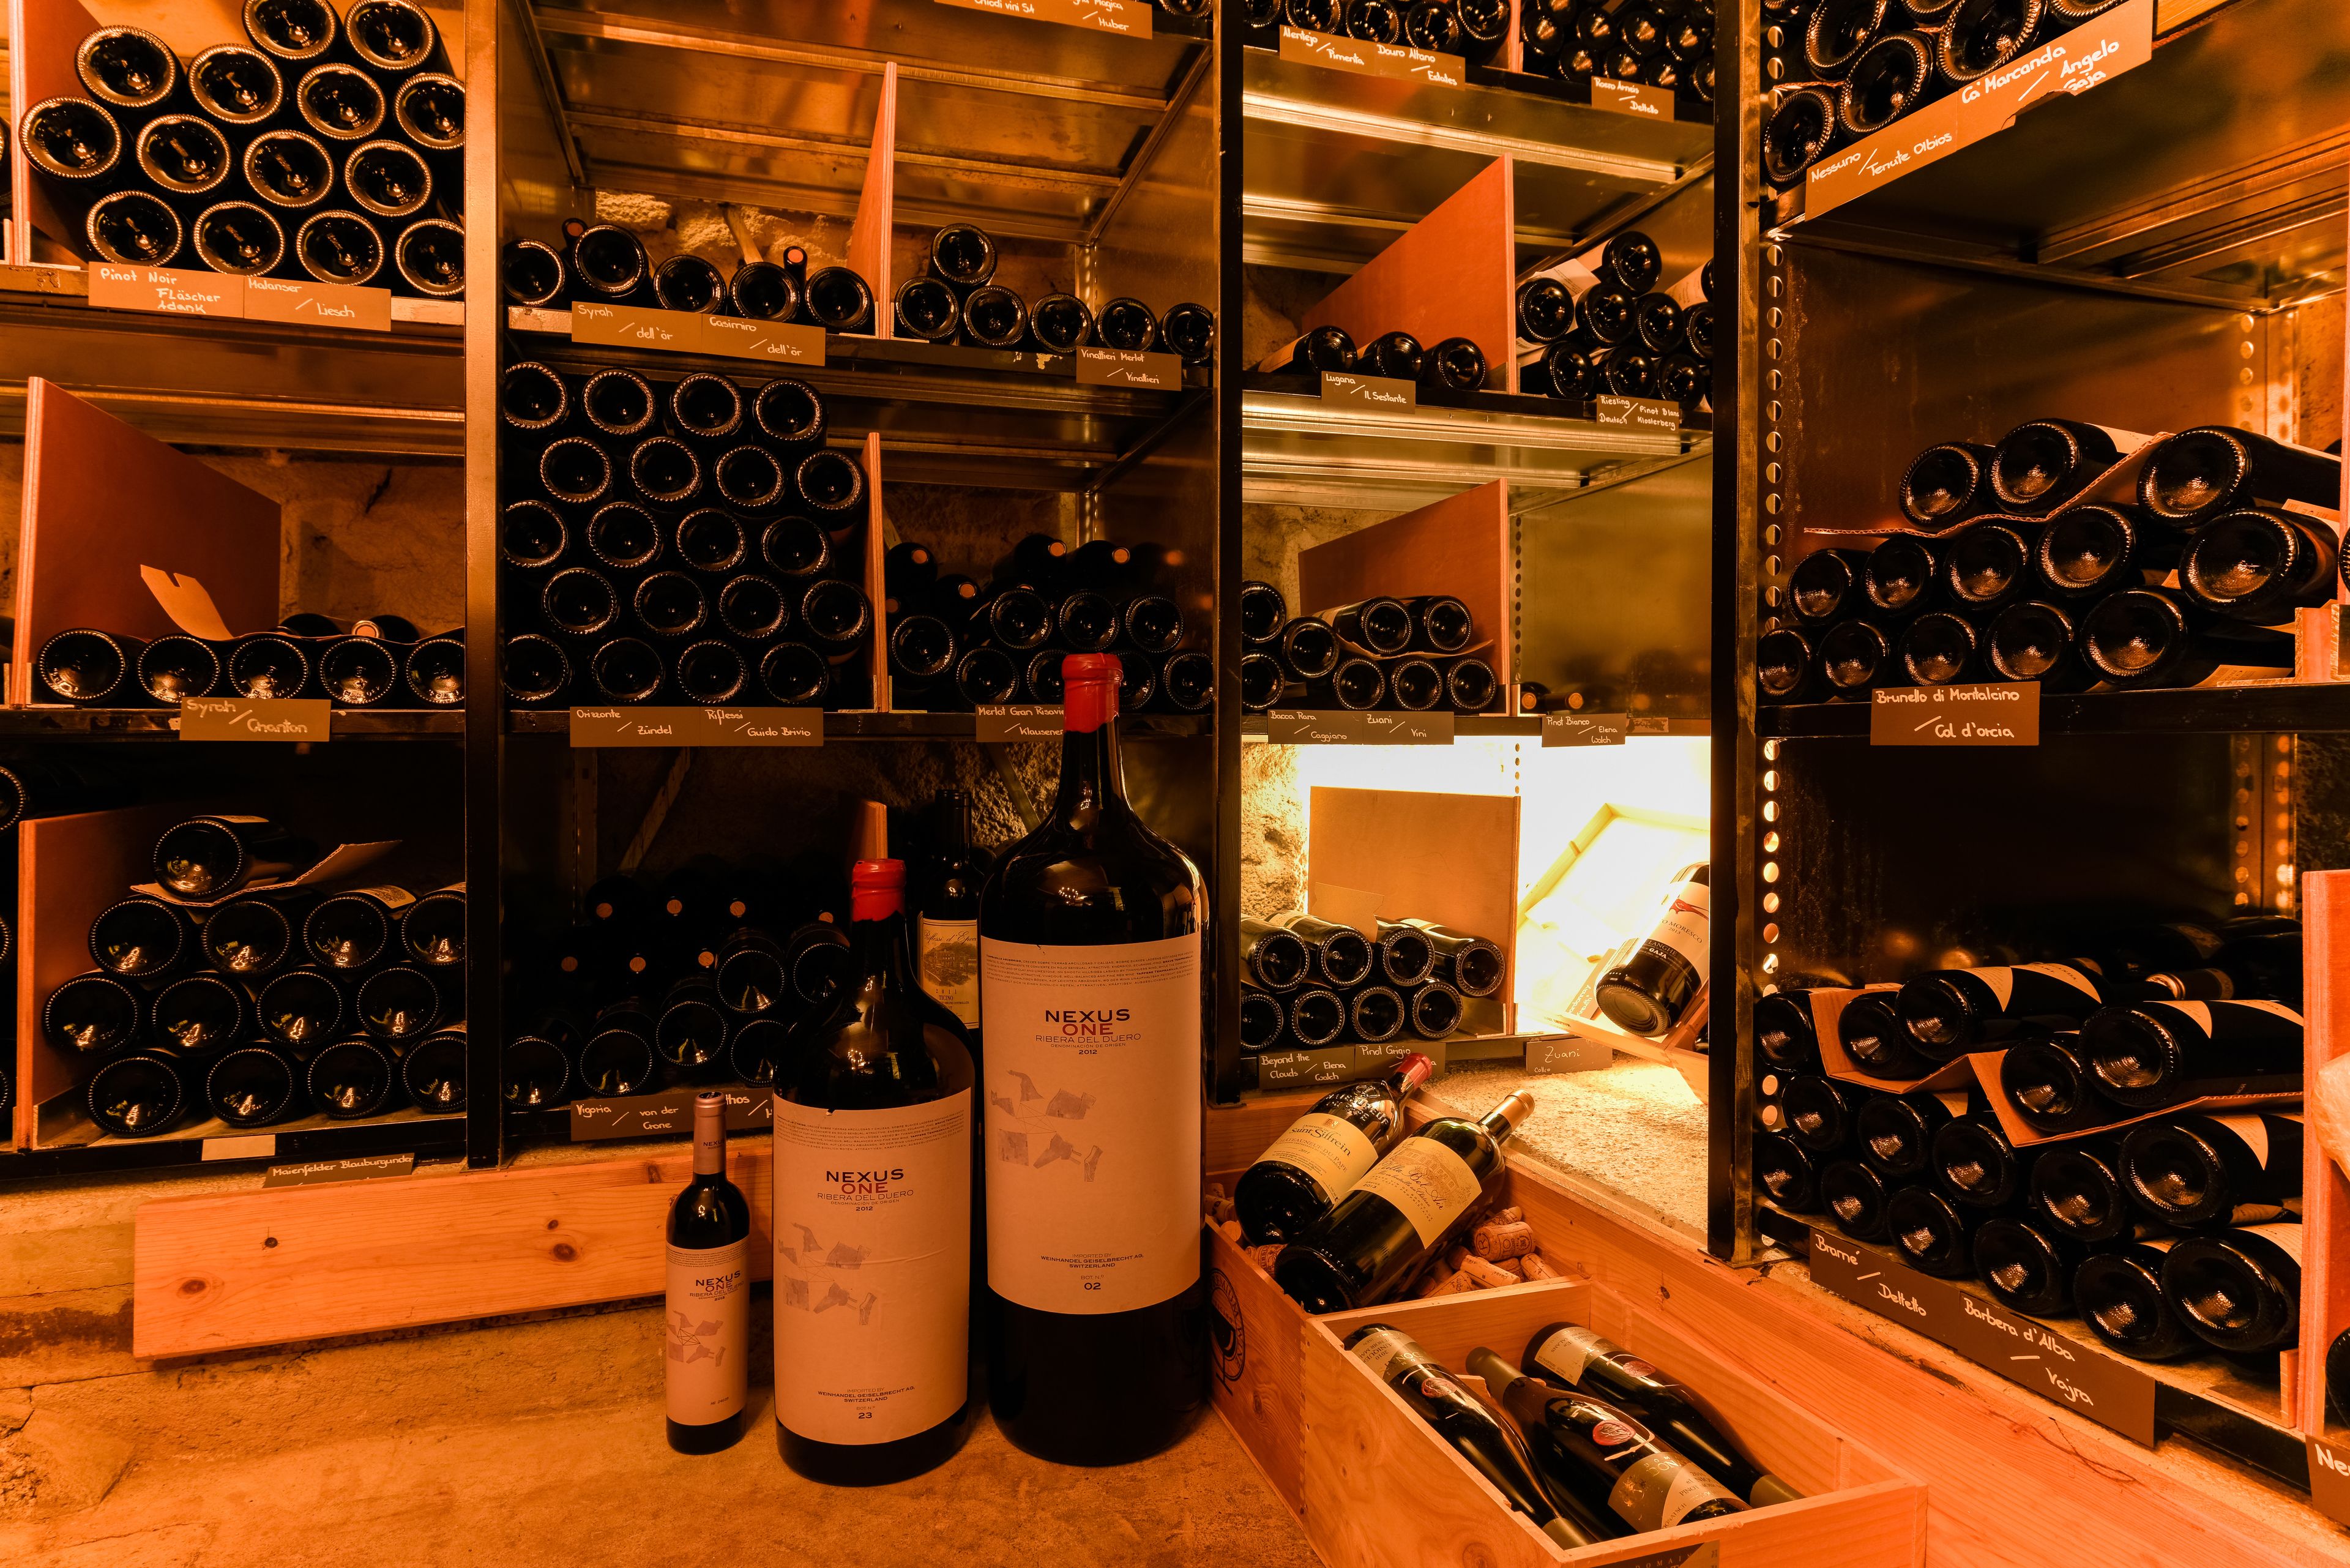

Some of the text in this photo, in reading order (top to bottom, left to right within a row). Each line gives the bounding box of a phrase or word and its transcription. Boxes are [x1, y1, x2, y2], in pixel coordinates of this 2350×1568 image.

[1005, 1, 1020, 11] vini
[1099, 17, 1129, 31] Huber
[1283, 27, 1318, 47] Alentejo
[1327, 47, 1364, 65] Pimenta
[1378, 44, 1436, 62] Douro Altano
[2060, 39, 2120, 78] Angelo
[1985, 45, 2065, 94] Marcanda
[1428, 71, 1457, 85] Estates
[1617, 81, 1639, 94] Arneis
[1630, 100, 1658, 114] Deltetto
[1867, 132, 1953, 177] Tenute Olbios
[1811, 152, 1862, 183] Nessuno
[100, 268, 177, 285] Pinot Noir
[317, 302, 354, 317] Liesch
[578, 305, 613, 319] Syrah
[1081, 349, 1144, 362] Vinattieri Merlot
[1326, 373, 1356, 386] Lugana
[1373, 392, 1407, 403] Sestante
[1600, 396, 1630, 408] Riesling
[1599, 413, 1627, 424] Deutsch
[1639, 406, 1679, 417] Pinot Blanc
[1638, 416, 1675, 431] Klosterberg
[1876, 687, 2020, 704] Brunello di Montalcino
[187, 700, 236, 718] Syrah
[576, 709, 621, 719] Orizzonte
[979, 707, 1005, 715] Merlot
[1271, 711, 1295, 720] Bacca
[705, 709, 743, 725] Riflessi
[1367, 714, 1392, 724] Zuani
[1546, 716, 1589, 726] Pinot Bianco
[247, 719, 308, 733] Chanton
[748, 728, 811, 736] Guido Brivio
[1411, 728, 1427, 737] Vini
[1311, 731, 1347, 742] Caggiano
[1668, 920, 1703, 943] MORESCO
[1649, 940, 1677, 955] LANGHE
[1649, 948, 1667, 959] GAJA
[1045, 1009, 1130, 1023] NEXUS
[1062, 1023, 1113, 1036] ONE
[1036, 1035, 1075, 1043] RIBERA
[1103, 1034, 1141, 1042] DUERO
[1359, 1045, 1411, 1059] Pinot Grigio
[1545, 1047, 1580, 1063] Zuani
[1261, 1053, 1293, 1067] Beyond
[1270, 1070, 1298, 1079] Clouds
[726, 1094, 750, 1105] thos
[273, 1155, 414, 1176] Maienfelder Blauburgunder
[826, 1168, 904, 1182] NEXUS
[841, 1182, 888, 1194] ONE
[880, 1189, 914, 1200] DUERO
[1815, 1234, 1860, 1265] Bramé
[696, 1270, 740, 1286] NEXUS
[706, 1280, 733, 1292] ONE
[728, 1281, 744, 1291] DUERO
[1878, 1283, 1927, 1316] Deltetto
[1964, 1297, 2018, 1336] Barbera
[857, 1388, 905, 1397] GEISELBRECHT
[2045, 1367, 2094, 1406] Vajra
[2314, 1443, 2350, 1476] Ne
[1679, 1485, 1699, 1496] PINOT
